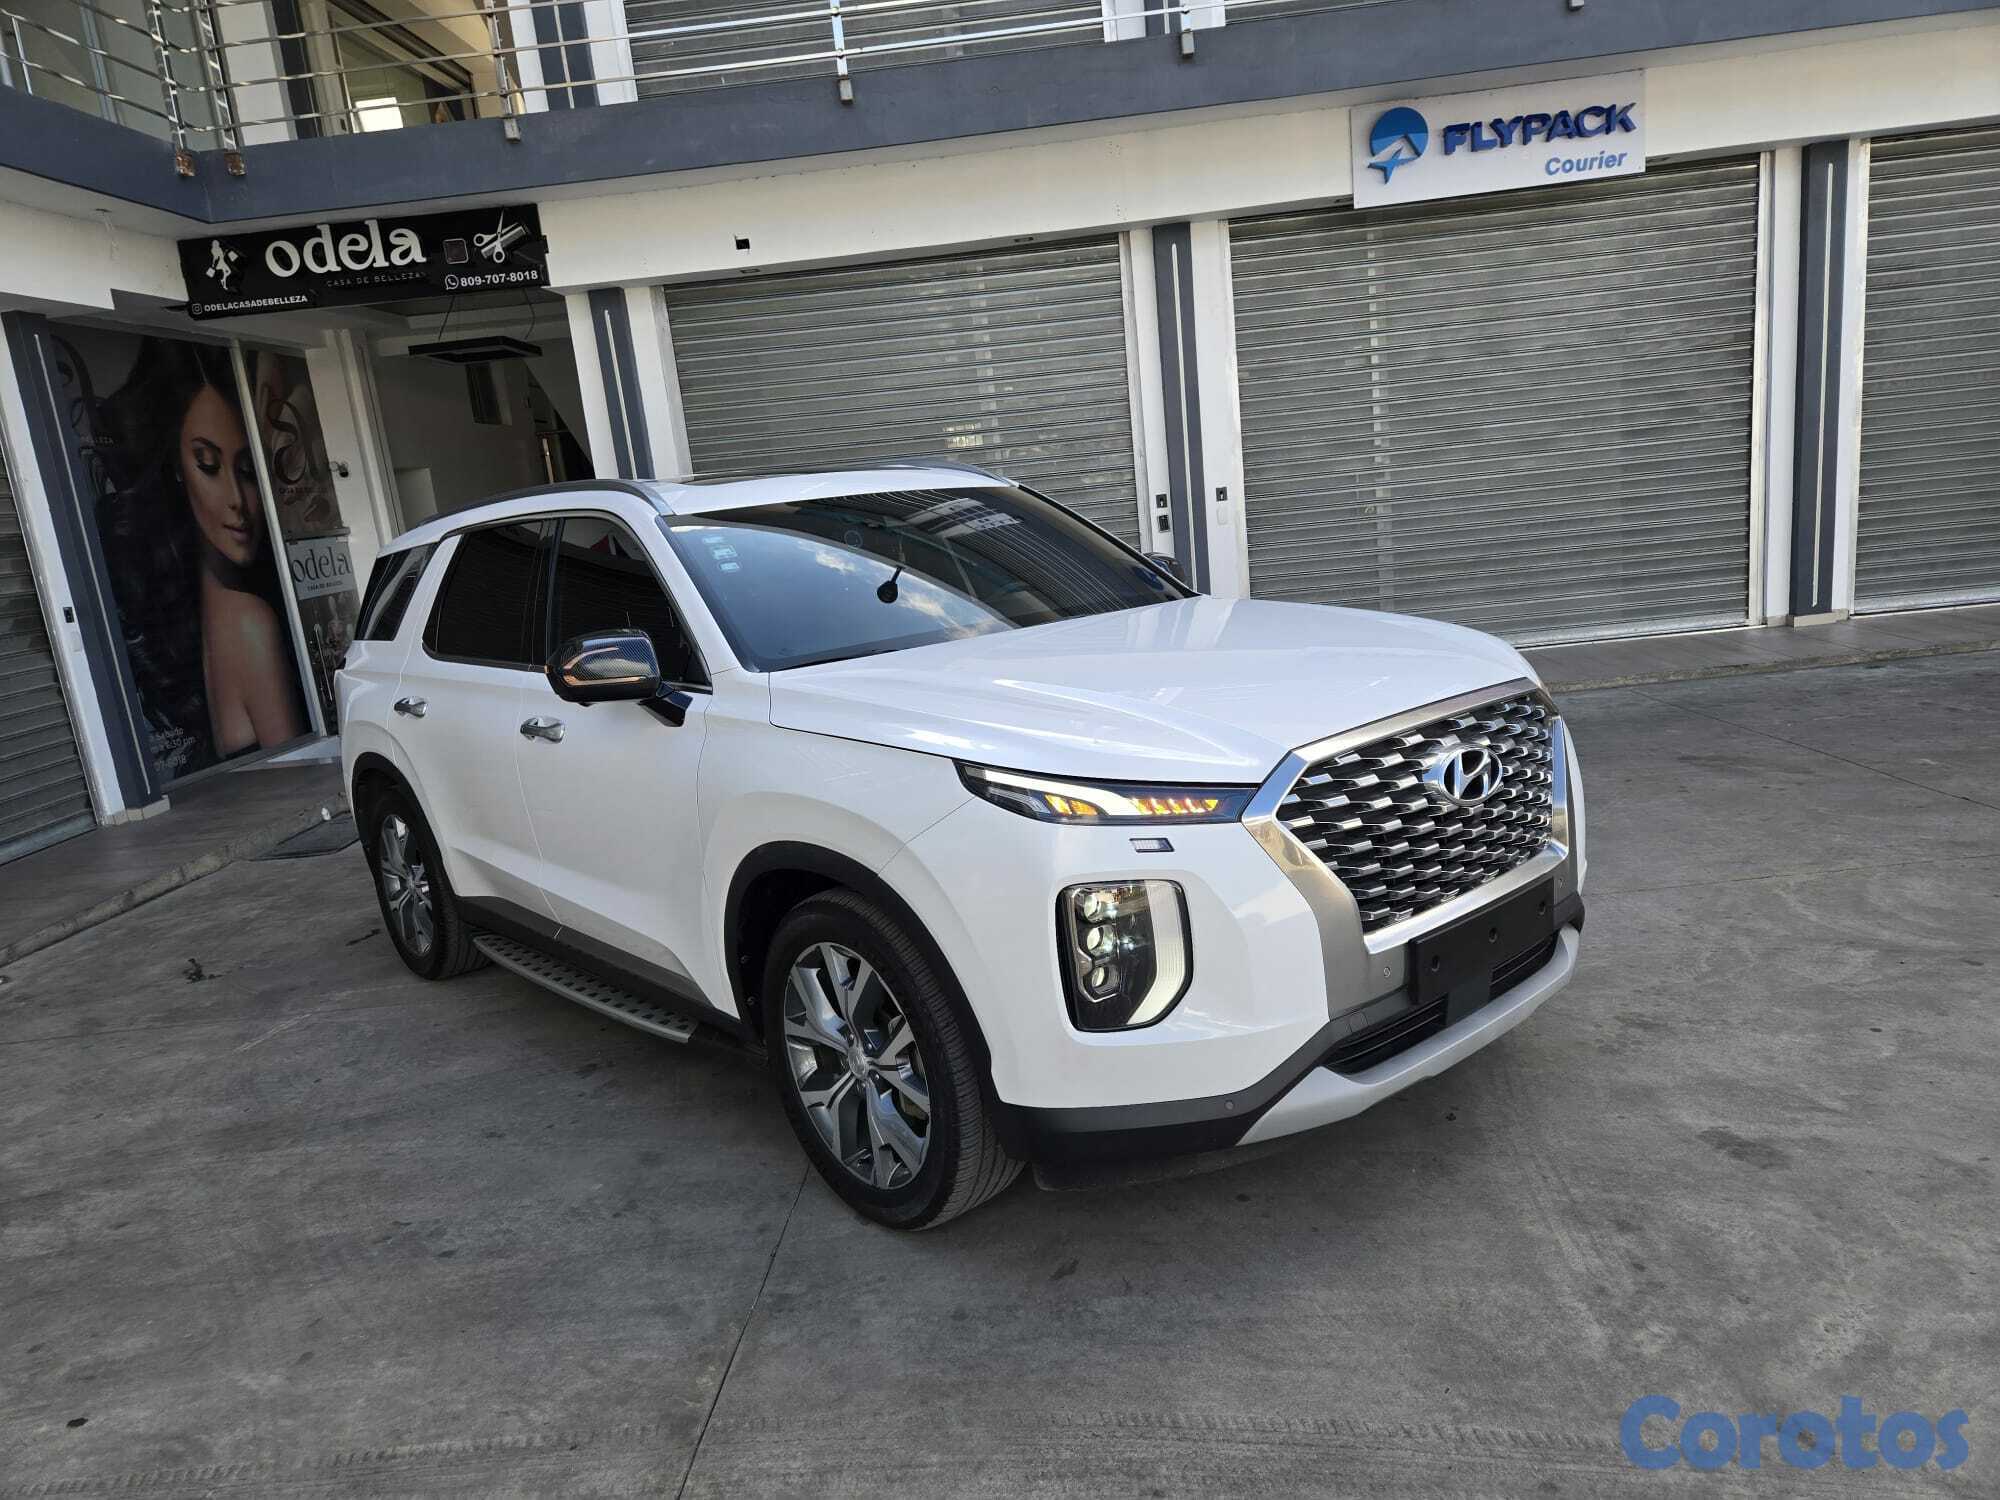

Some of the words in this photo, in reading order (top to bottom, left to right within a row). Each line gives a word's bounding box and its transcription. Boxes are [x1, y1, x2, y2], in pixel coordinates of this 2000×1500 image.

[1443, 102, 1637, 155] FLYPACK
[1545, 151, 1627, 175] Courier
[265, 218, 427, 278] odela
[461, 270, 538, 287] 809-707-8018
[204, 295, 308, 312] ODELACASADEBELLEZA
[291, 546, 351, 583] odela
